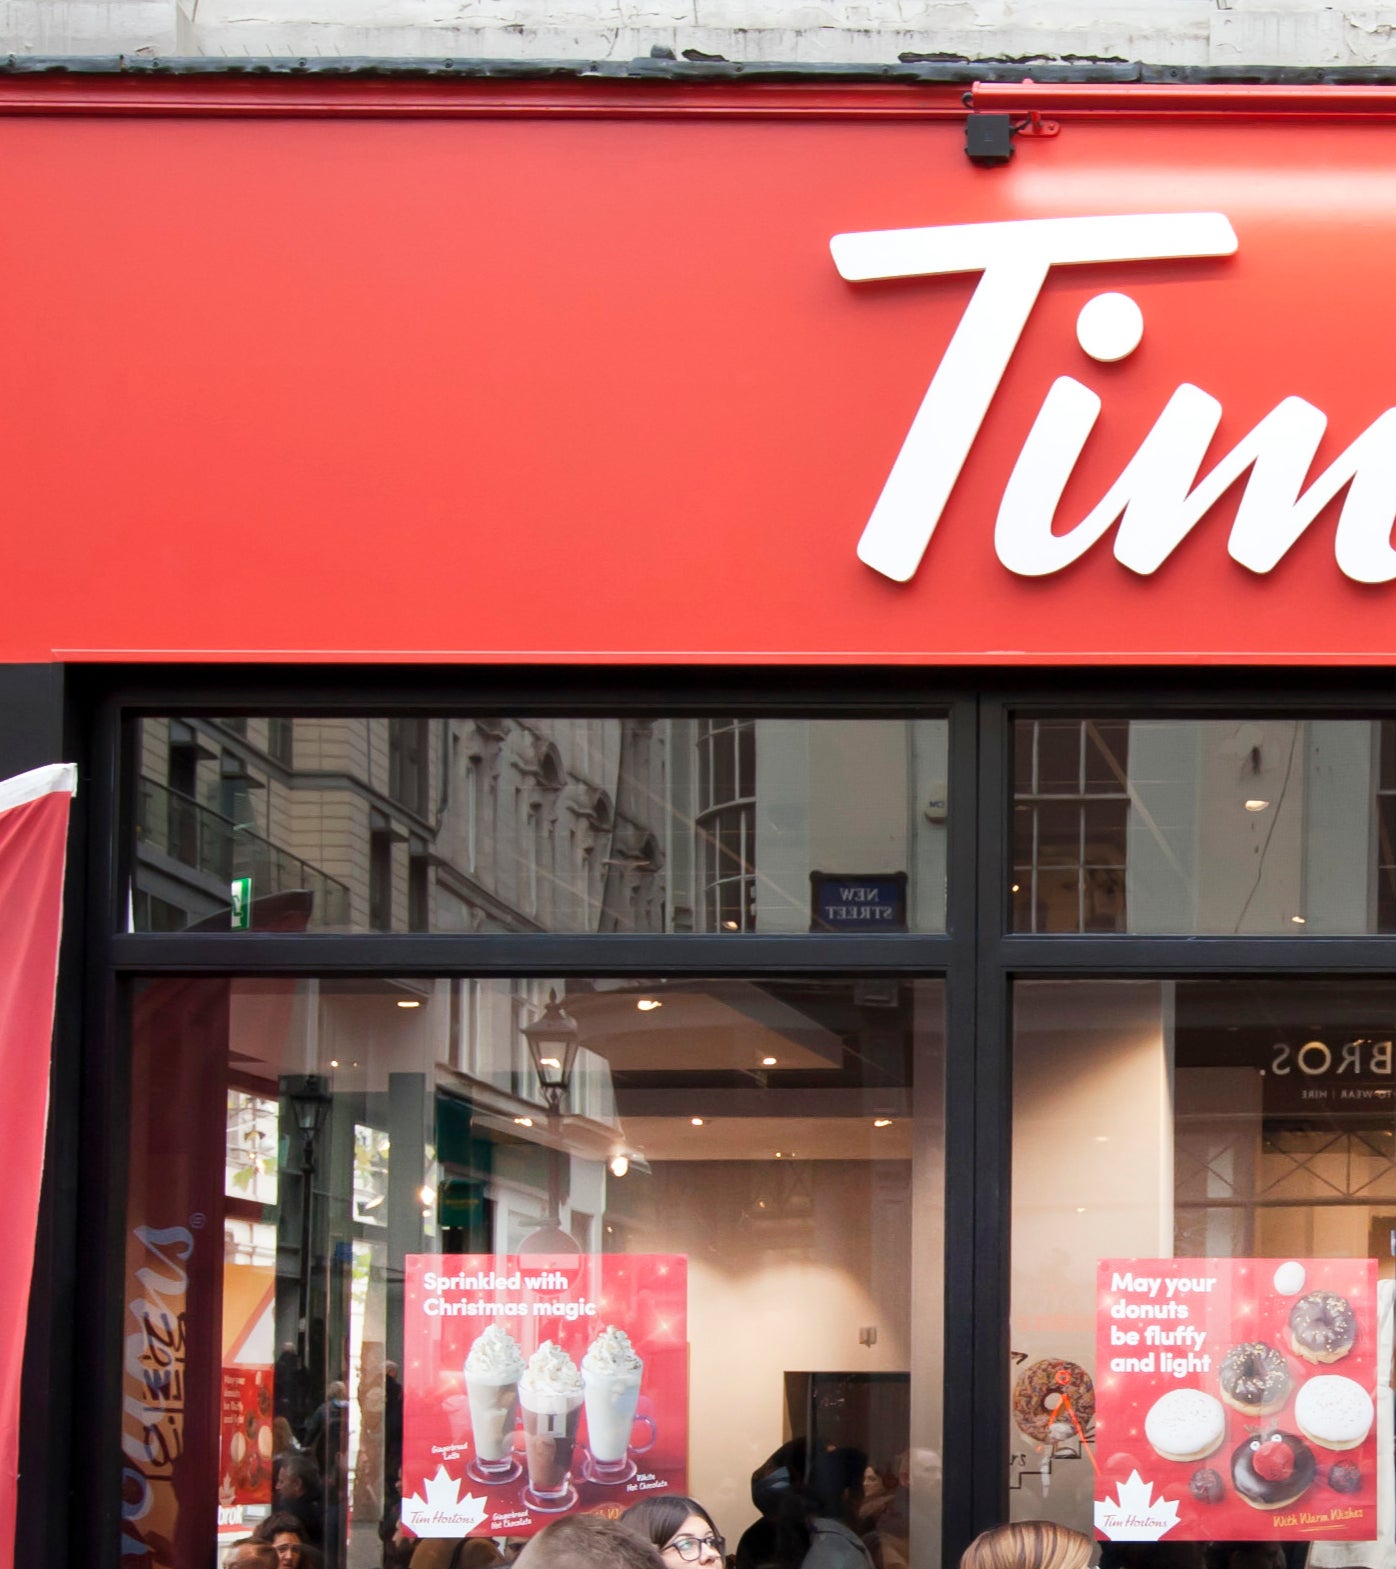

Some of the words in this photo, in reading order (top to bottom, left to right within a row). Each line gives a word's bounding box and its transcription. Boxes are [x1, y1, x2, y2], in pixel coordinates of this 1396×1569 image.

[424, 1272, 520, 1294] Sprinkled
[524, 1272, 568, 1290] with
[1111, 1272, 1162, 1297] May
[1164, 1277, 1217, 1297] your
[423, 1298, 529, 1316] Christmas
[532, 1298, 597, 1320] magic
[1110, 1299, 1189, 1319] donuts
[1110, 1325, 1140, 1345] be
[1144, 1325, 1207, 1351] fluffy
[1110, 1352, 1155, 1372] and
[1160, 1352, 1211, 1378] light
[410, 1511, 431, 1525] Tim
[432, 1511, 476, 1525] Hortons
[1103, 1514, 1124, 1528] Tim
[1124, 1514, 1169, 1528] Hortons
